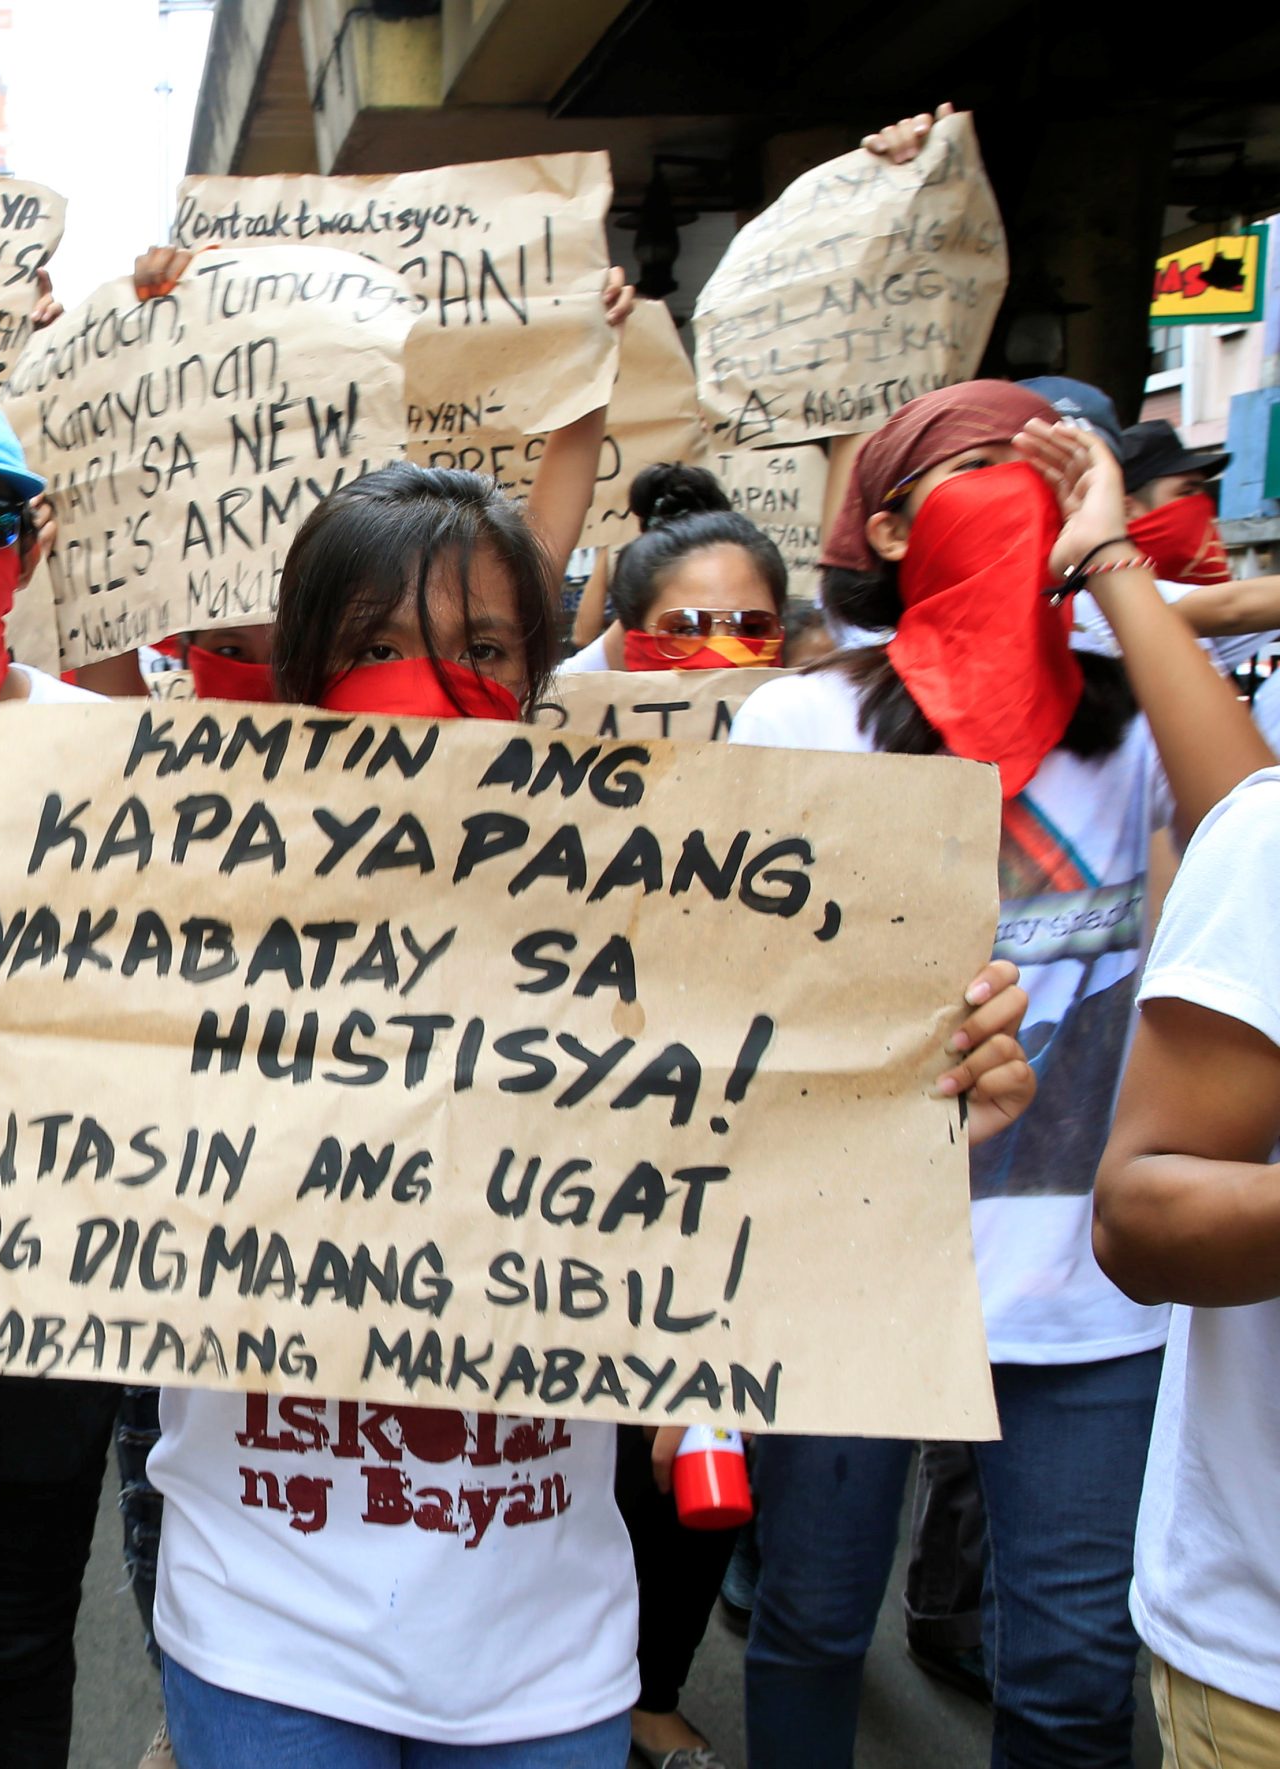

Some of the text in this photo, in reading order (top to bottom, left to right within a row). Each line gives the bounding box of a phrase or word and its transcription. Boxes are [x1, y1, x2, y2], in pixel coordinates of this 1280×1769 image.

[138, 430, 200, 499] SA
[730, 486, 800, 513] APAN
[766, 457, 797, 475] SA
[122, 710, 652, 808] KAMTIN ANG
[510, 929, 638, 1005] SA
[189, 1003, 775, 1135] HUSTISYA!
[295, 1135, 434, 1203] ANG
[485, 1147, 732, 1237] UGAT
[68, 1217, 455, 1319] DIGMAANG
[484, 1214, 752, 1334] SIBIL!
[360, 1325, 783, 1426] MAKABAYAN
[238, 1465, 572, 1550] ng Bayan
